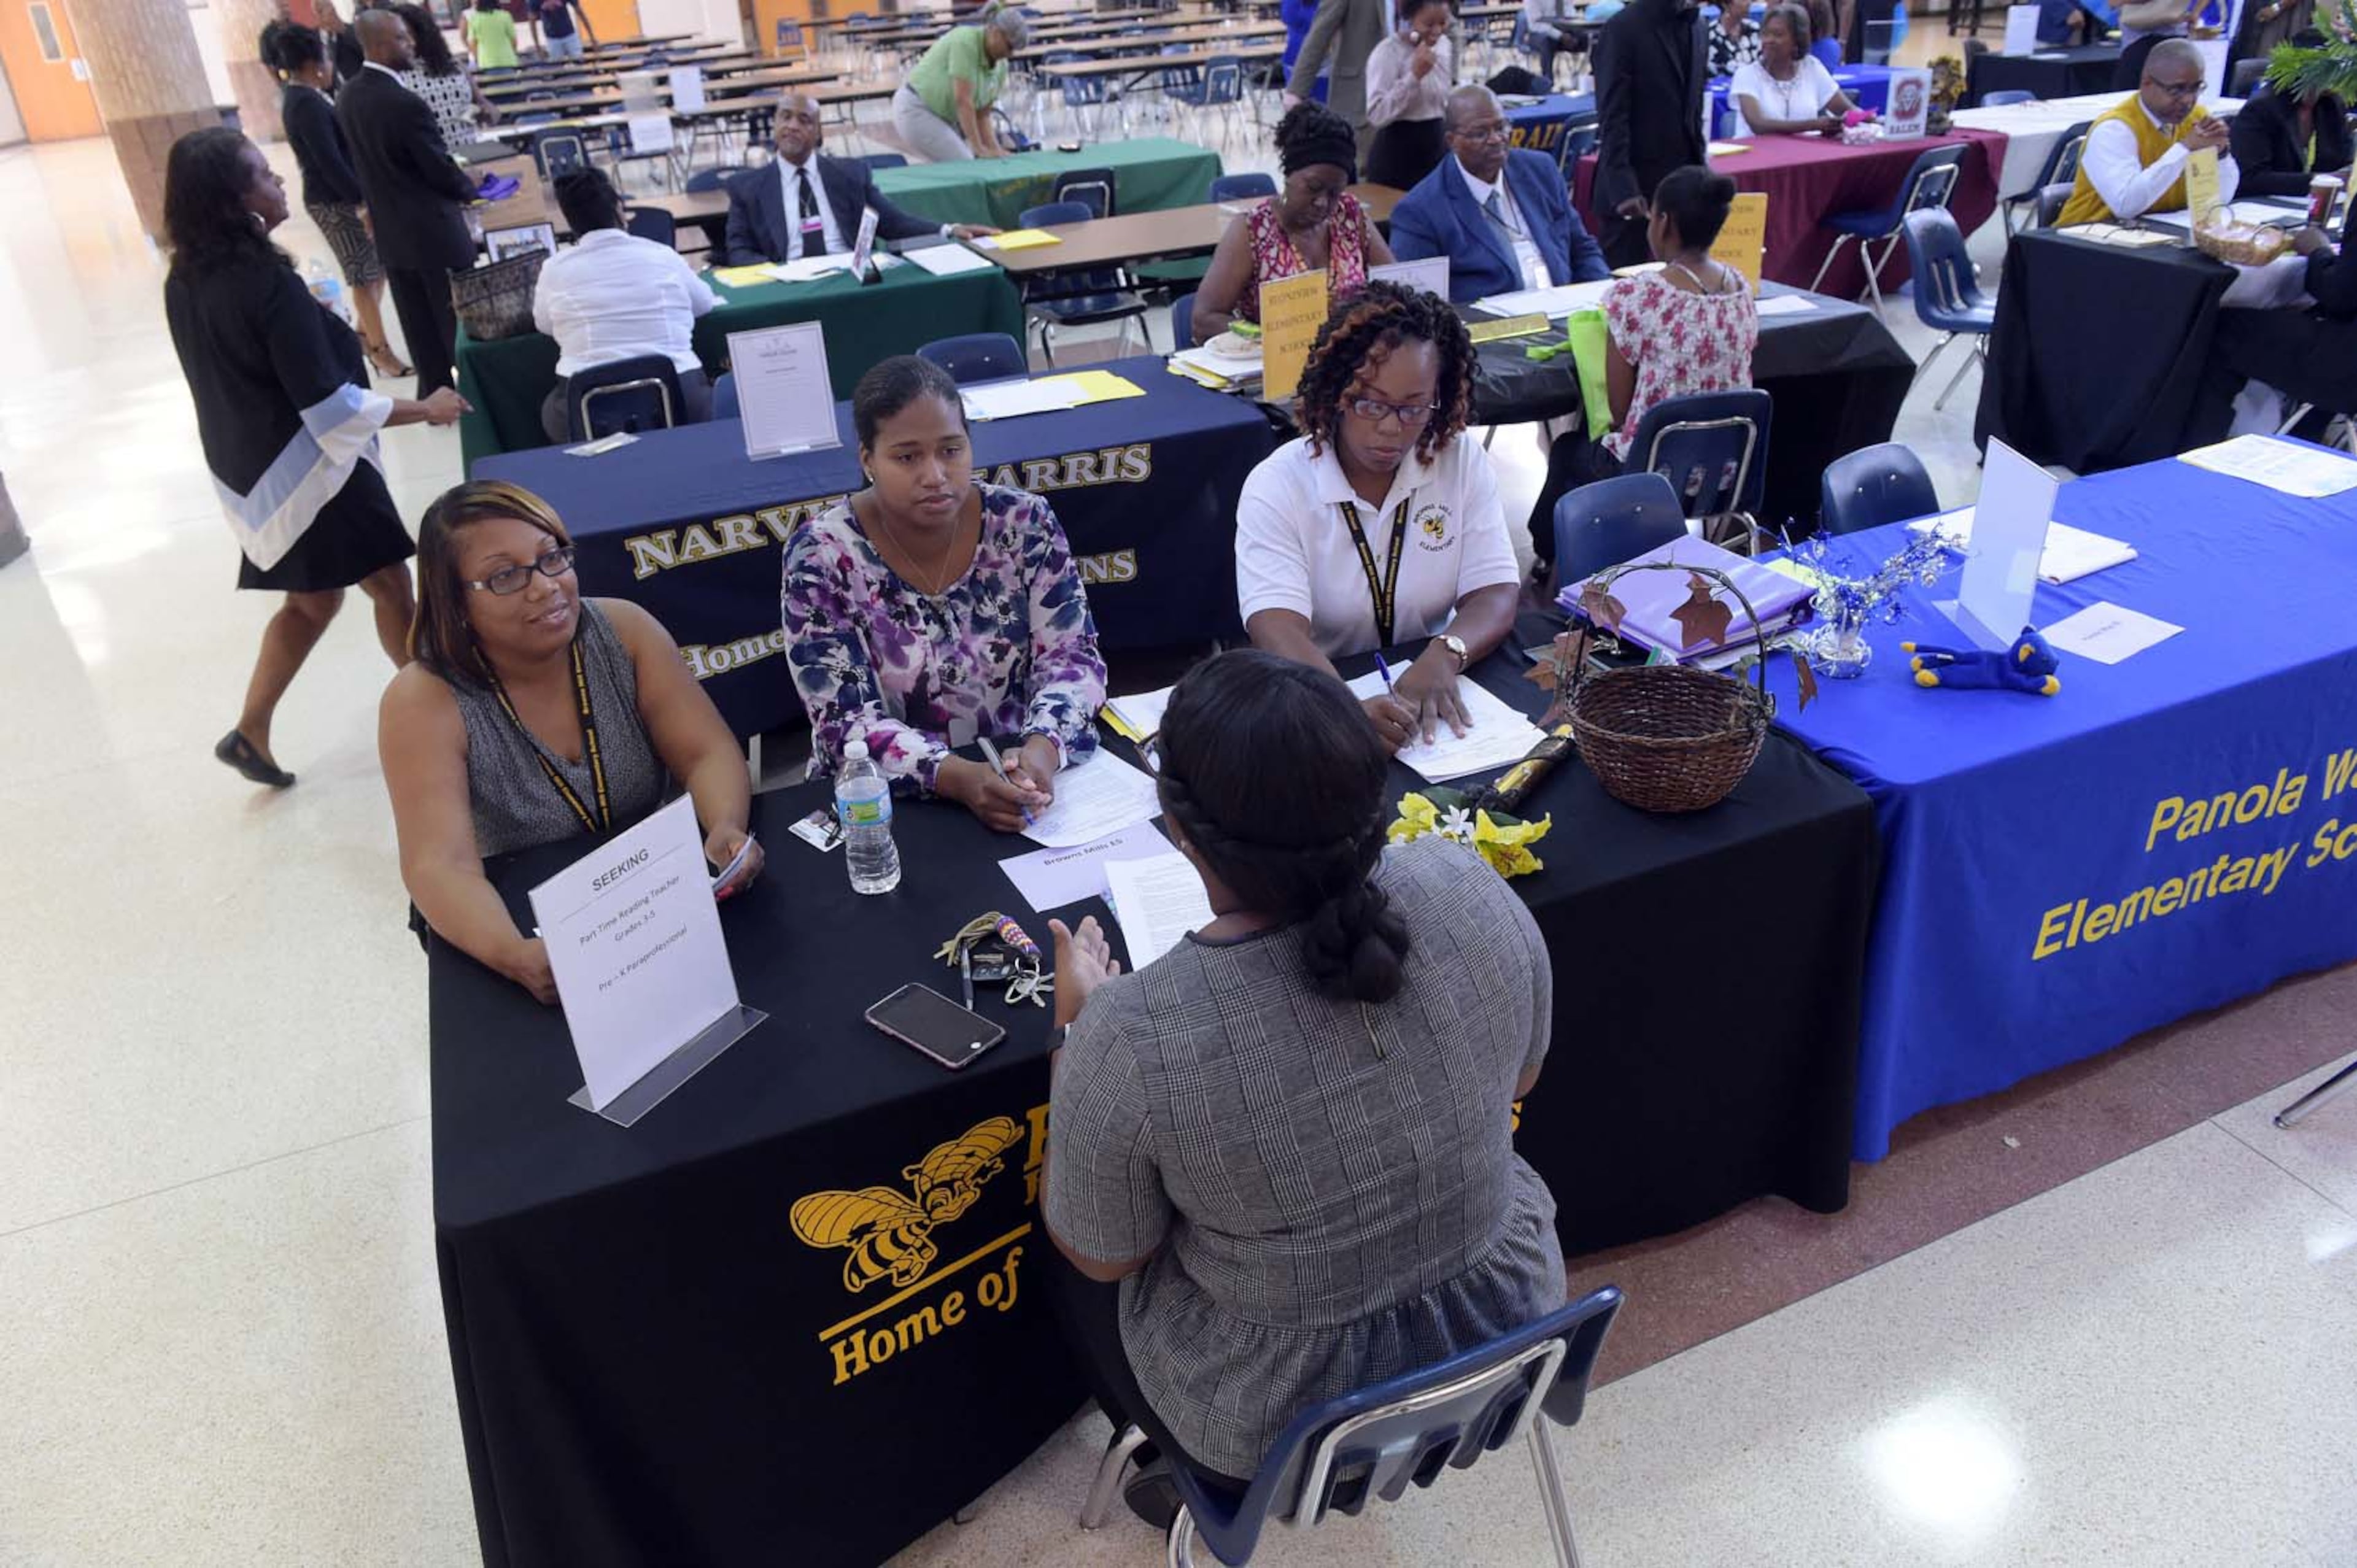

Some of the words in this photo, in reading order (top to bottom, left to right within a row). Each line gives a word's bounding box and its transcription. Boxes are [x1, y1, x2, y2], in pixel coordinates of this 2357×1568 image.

[972, 443, 1151, 492] ARRIS
[2145, 767, 2308, 853] Panola
[592, 848, 649, 892] SEEKING
[1044, 851, 1082, 865] Browns
[579, 930, 597, 946] Part
[598, 915, 617, 933] Time
[619, 895, 649, 919] Reading
[651, 875, 679, 898] Teacher
[614, 921, 642, 942] Grades
[2032, 842, 2300, 960] Elementary
[598, 979, 613, 992] Pre
[627, 922, 687, 973] Paraprofessional
[830, 1291, 966, 1386] Home
[977, 1246, 1023, 1311] of
